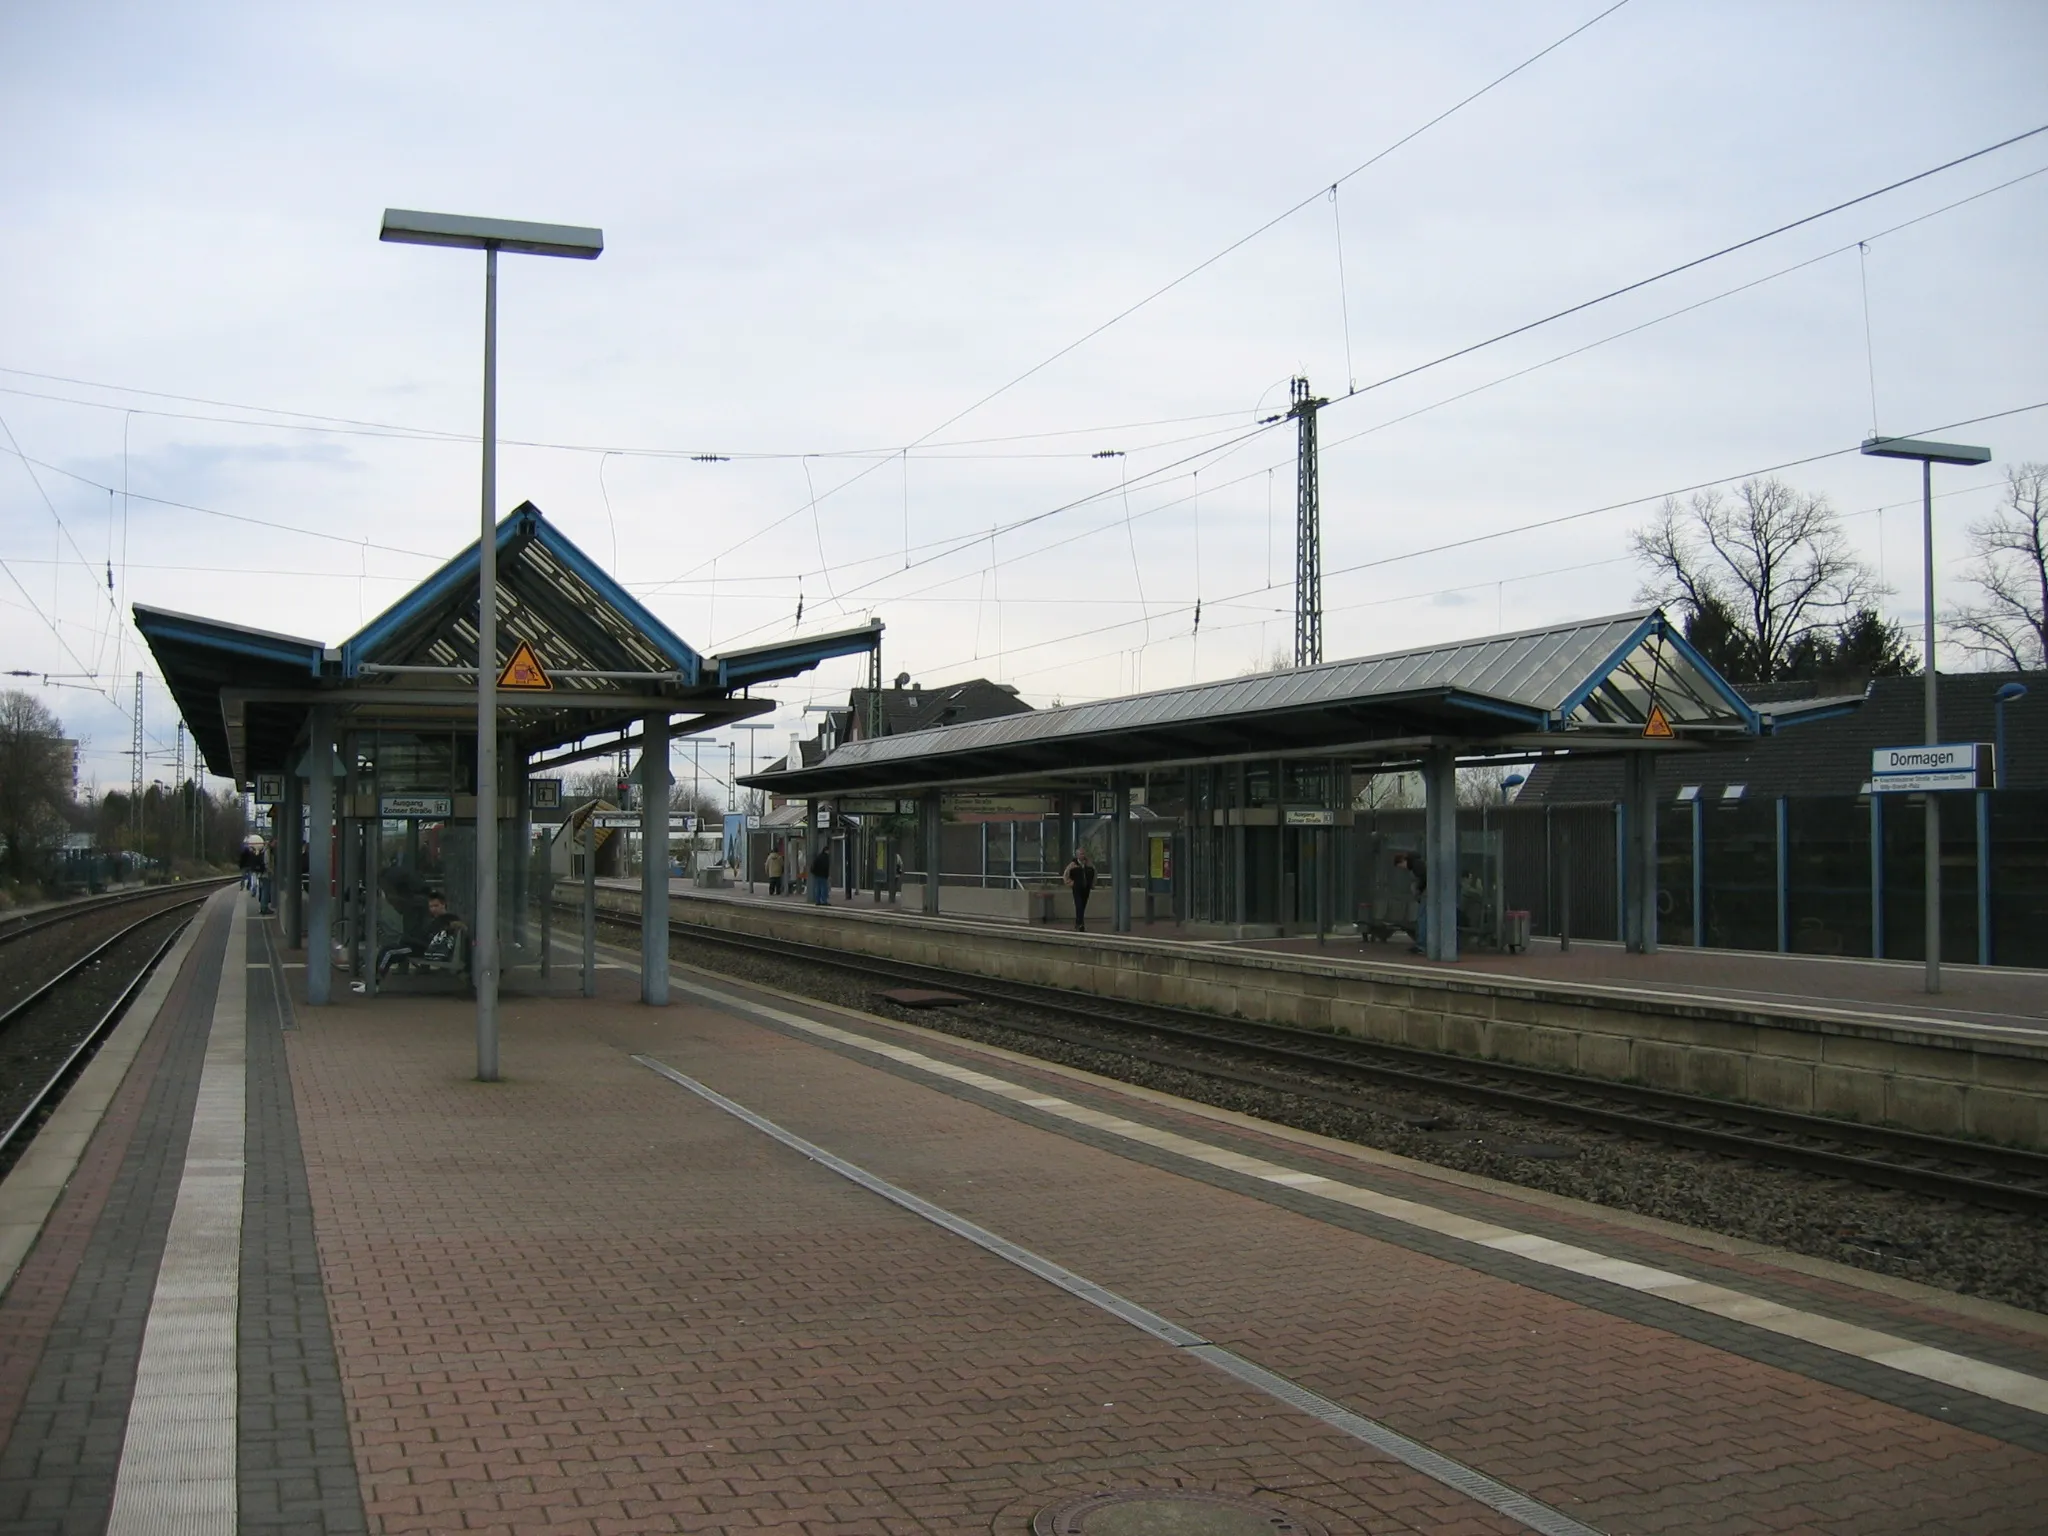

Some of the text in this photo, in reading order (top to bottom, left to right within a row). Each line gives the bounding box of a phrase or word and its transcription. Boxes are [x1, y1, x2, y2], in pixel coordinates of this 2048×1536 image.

[1890, 752, 1954, 767] Dormagen
[392, 799, 424, 808] Ausgang
[409, 807, 433, 815] Straße
